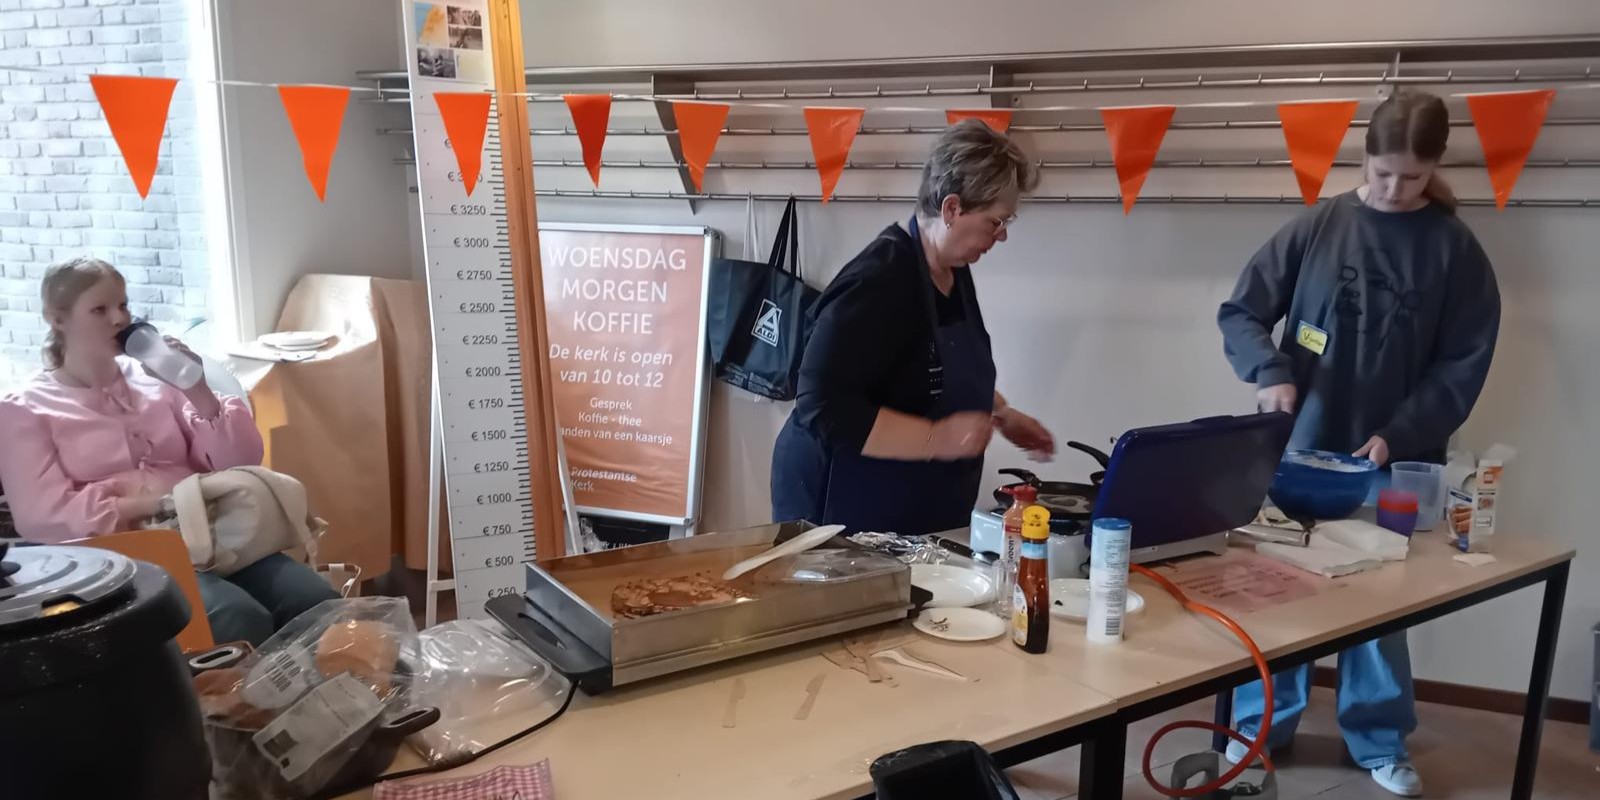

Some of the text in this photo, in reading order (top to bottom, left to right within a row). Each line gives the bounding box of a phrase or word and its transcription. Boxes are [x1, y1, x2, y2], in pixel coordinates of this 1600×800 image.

[448, 172, 482, 182] € 30
[450, 204, 486, 216] € 3250
[454, 238, 489, 248] € 3000
[549, 246, 686, 271] WOENSDAG
[457, 270, 492, 280] € 2750
[562, 278, 668, 302] MORGEN
[460, 303, 494, 312] € 2500
[574, 310, 654, 334] KOFFIE
[462, 335, 498, 344] € 2250
[550, 344, 672, 368] De kerk is open
[466, 366, 500, 377] € 2000
[560, 369, 664, 388] van 10 tot 12
[468, 398, 504, 409] € 1750
[590, 398, 632, 410] Gesprek
[578, 412, 608, 424] Koffie
[618, 414, 642, 426] thee
[472, 430, 506, 441] € 1500
[560, 426, 672, 446] anden van een kaarsje
[474, 462, 509, 473] € 1250
[571, 467, 637, 482] Protestantse
[571, 480, 594, 492] Kerk
[477, 493, 512, 504] € 1000
[483, 524, 512, 536] € 750
[486, 556, 514, 568] € 500
[498, 586, 516, 596] 250
